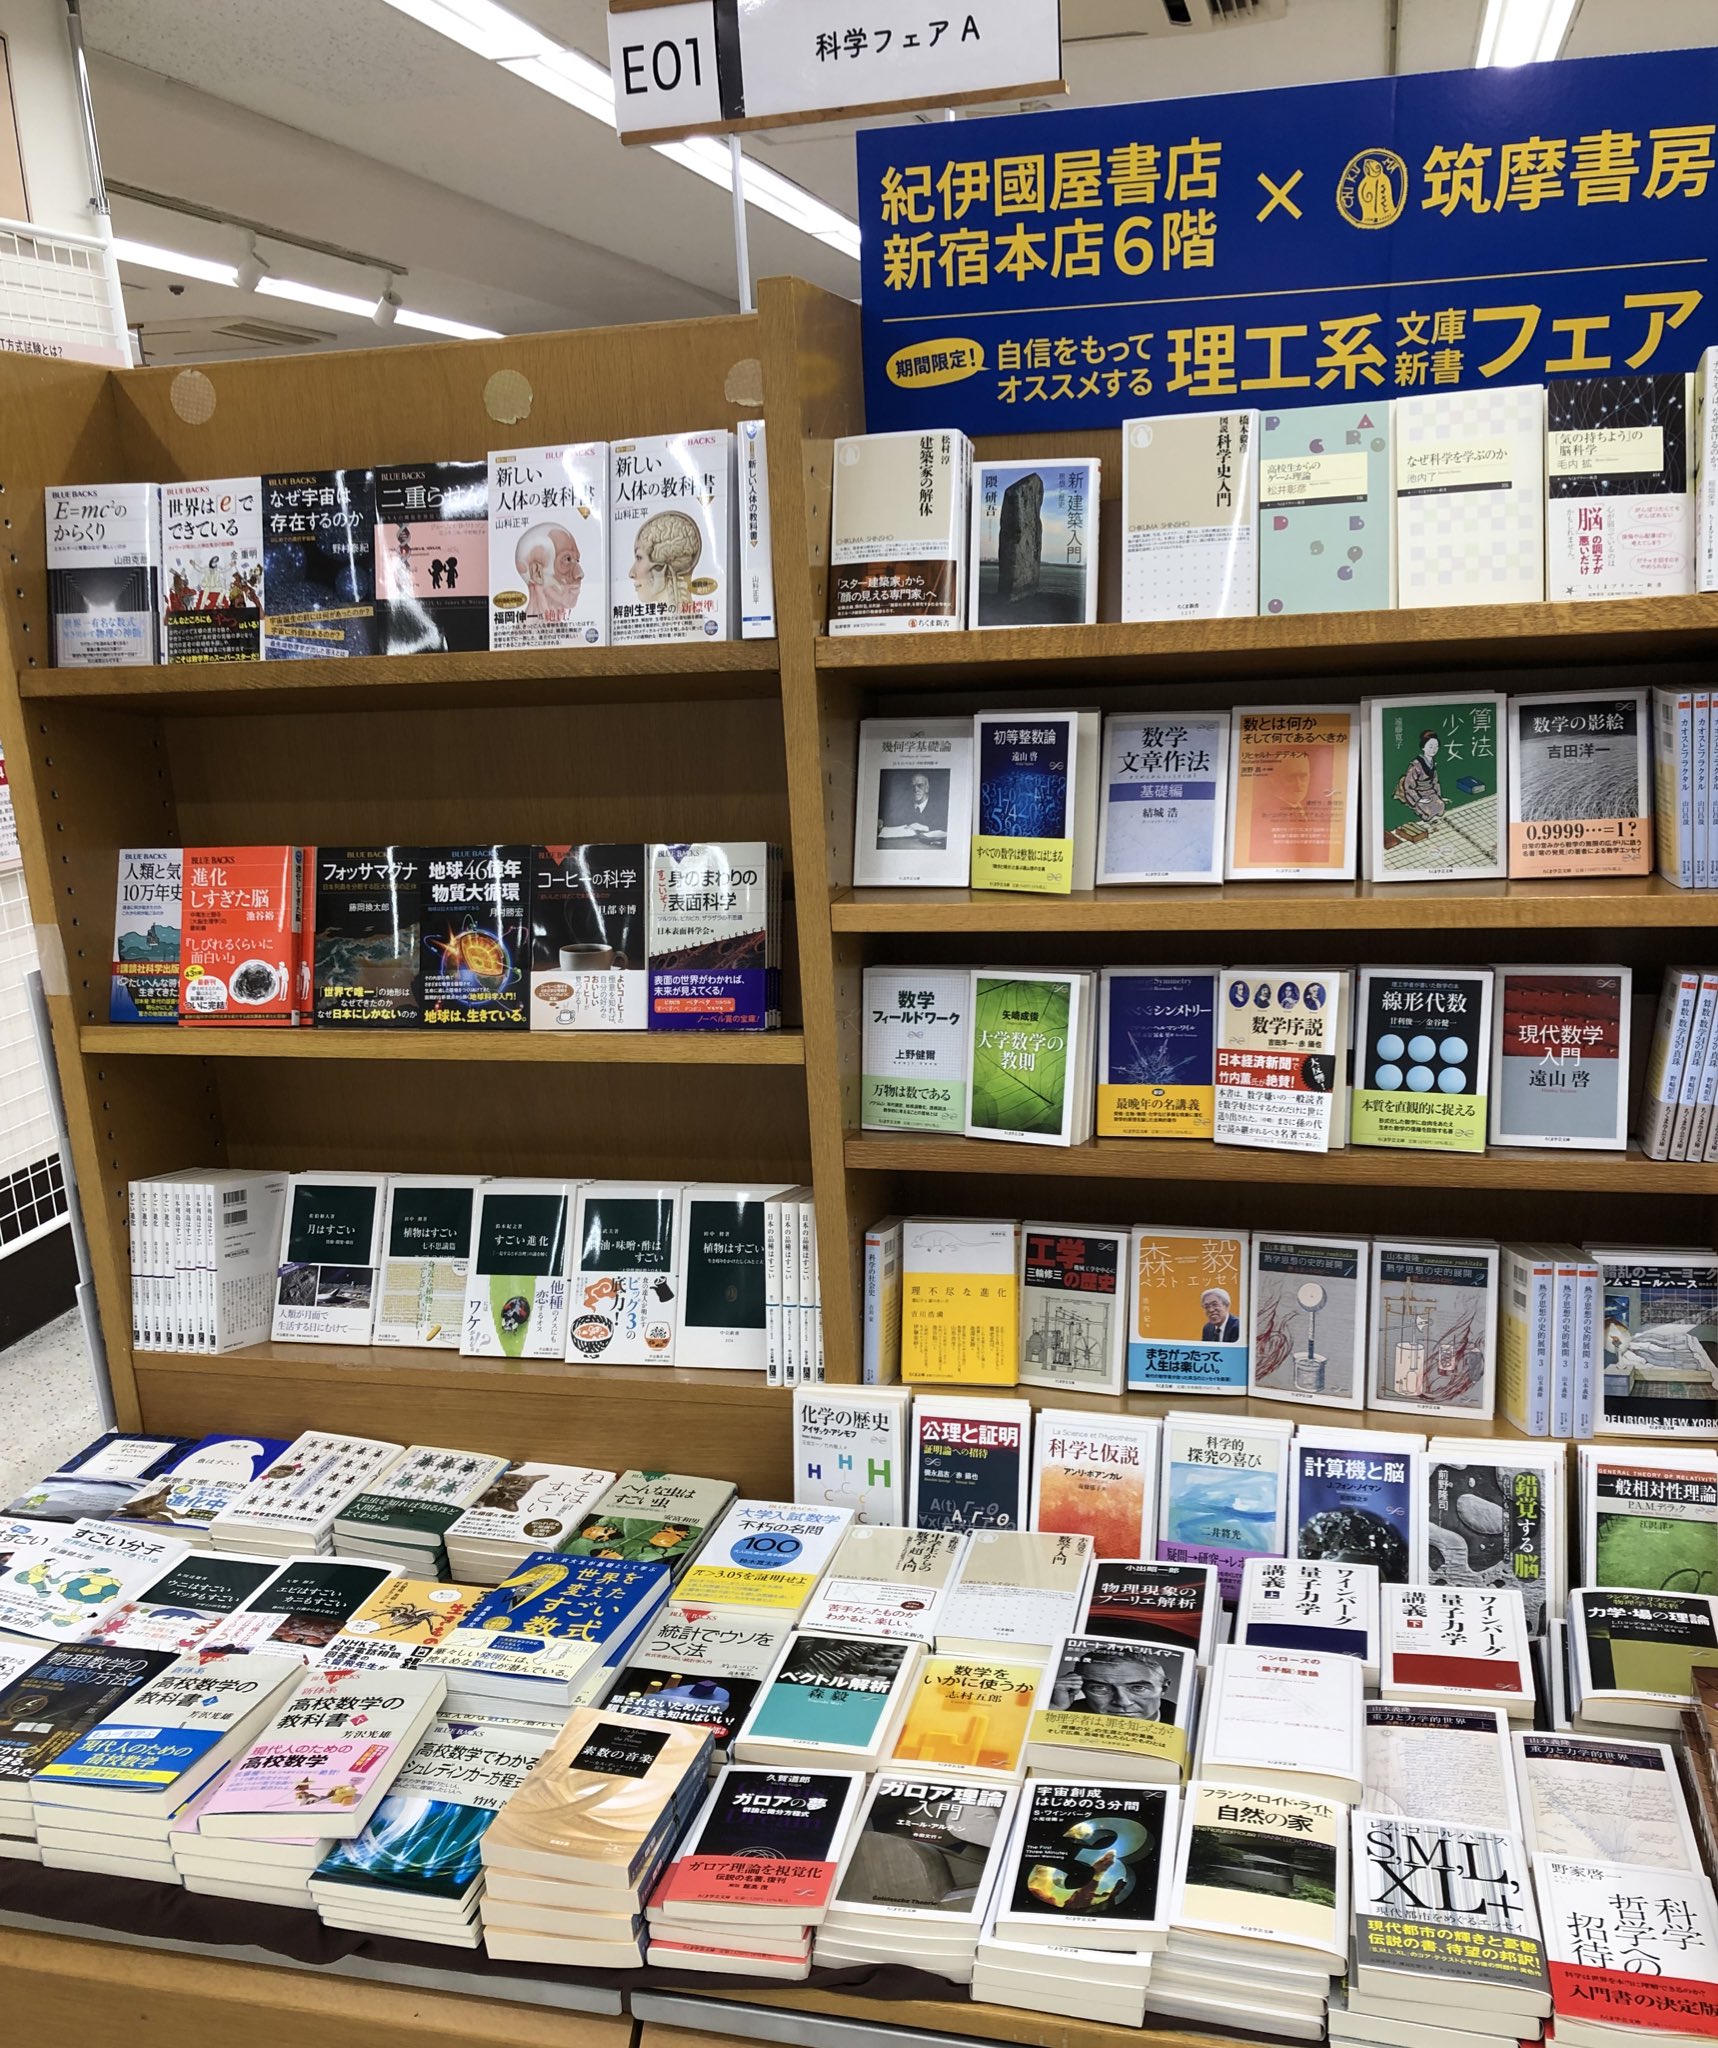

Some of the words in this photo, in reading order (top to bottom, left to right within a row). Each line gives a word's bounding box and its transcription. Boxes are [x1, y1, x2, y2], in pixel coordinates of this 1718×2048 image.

[815, 20, 950, 62] 科学フェア
[961, 15, 981, 42] A
[622, 37, 702, 95] E01
[880, 138, 1222, 226] 紀伊國屋書店
[1421, 124, 1716, 217] 筑摩書房
[883, 208, 1217, 291] 新宿本店6階
[1396, 308, 1467, 347] 文庫
[1472, 290, 1704, 378] フェア
[997, 333, 1154, 371] 自信をもって
[1166, 312, 1388, 397] 理工系
[895, 349, 977, 379] 期間限定!
[1395, 348, 1465, 386] 新書
[997, 368, 1154, 404] オススメする
[1407, 448, 1508, 467] なぜ科学を学ぶのか
[919, 435, 934, 518] 建築家の解体
[748, 461, 758, 542] 新しい人体の教科書
[1066, 471, 1084, 564] 新・建築入門
[54, 522, 106, 543] からくり
[168, 519, 239, 540] できている
[1579, 535, 1590, 575] 悪いだけ
[1592, 535, 1603, 575] の調子が
[1244, 717, 1317, 731] 数とは何か
[1470, 707, 1494, 758] 算法
[1532, 712, 1625, 735] 数学の影絵
[993, 729, 1057, 745] 初等整数論
[1141, 726, 1188, 749] 数学
[1243, 732, 1348, 745] そして何であるべきか
[1443, 713, 1465, 763] 少女
[1011, 752, 1028, 762] 遠山
[1546, 743, 1611, 760] 吉田洋一
[1680, 718, 1690, 791] カオスとフラクタル
[1697, 718, 1707, 791] カオスとフラクタル
[1118, 750, 1210, 774] 文章作法
[1140, 783, 1183, 798] 基礎編
[1142, 807, 1164, 819] 結城
[191, 867, 228, 887] 進化
[322, 862, 418, 881] フォッサマグナ
[538, 869, 637, 889] コーヒーの科学
[668, 869, 758, 887] 身のまわりの
[122, 884, 183, 902] 10万年史
[190, 888, 270, 909] しすぎた脳
[668, 892, 737, 912] 表面科学
[348, 903, 390, 913] 藤岡換太郎
[653, 974, 746, 986] 表面の世界がわかれば、
[319, 986, 411, 998] 「世界で唯一」の地形は
[591, 975, 599, 1013] おいしい
[653, 986, 724, 997] 未来が見えてくる!
[340, 999, 394, 1008] なぜできたのか
[1381, 990, 1468, 1014] 線形代数
[317, 1008, 418, 1020] なぜ日本にしかないのか
[424, 1008, 528, 1024] 地球は、生きている。
[872, 1010, 961, 1026] フィールドワーク
[1252, 1016, 1324, 1037] 数学序説
[1519, 1024, 1603, 1045] 現代数学
[977, 1030, 1064, 1053] 大学数学の
[894, 1049, 936, 1061] 上野健爾
[1000, 1053, 1036, 1071] 教則
[1538, 1046, 1582, 1067] 入門
[873, 1083, 951, 1102] 万物は数である
[1117, 1098, 1201, 1112] 最晩年の名講義
[1361, 1099, 1476, 1118] 本質を直観的に捉える
[307, 1223, 357, 1236] 月はすごい
[403, 1227, 459, 1239] 植物はすごい
[421, 1241, 456, 1251] 七不思議篇
[703, 1242, 765, 1254] 植物はすごい
[767, 1213, 776, 1280] 日本の品種はすごい
[784, 1213, 793, 1280] 日本の品種はすごい
[1026, 1238, 1086, 1269] 工学
[634, 1252, 664, 1263] すごい
[867, 1253, 876, 1297] 科学の社会史
[1026, 1267, 1063, 1280] 三輪修三
[1141, 1273, 1239, 1289] ベスト・エッセイ
[911, 1286, 1008, 1299] 理不尽な進化
[1603, 1278, 1698, 1289] レム・コールハース
[278, 1309, 329, 1321] 人類が月面で
[1145, 1347, 1224, 1364] まちがったって、
[1145, 1360, 1221, 1376] 人生は楽しい。
[800, 1404, 890, 1433] 化学の歴史
[802, 1424, 857, 1438] アイザック・アシモフ
[921, 1420, 1019, 1447] 公理と証明
[923, 1444, 989, 1460] 証明論への招待
[1048, 1438, 1140, 1466] 科学と仮説
[1206, 1436, 1244, 1452] 科学的
[1187, 1447, 1262, 1468] 探究の喜び
[1063, 1467, 1123, 1480] アンリ・ポアンカレ
[1304, 1456, 1405, 1484] 計算機と脳
[1598, 1467, 1631, 1475] GENERAL
[1633, 1470, 1662, 1478] THEORY
[1676, 1474, 1717, 1483] RELATIVITY
[1597, 1479, 1717, 1504] 一般相対性理論
[738, 1519, 824, 1536] 不朽の名問
[1513, 1472, 1539, 1580] 錯覚する脳
[72, 1527, 167, 1556] すごい分子
[743, 1537, 801, 1554] 100
[576, 1567, 645, 1586] 世界を
[1125, 1564, 1181, 1575] 小出昭一郎
[1261, 1564, 1287, 1589] 講義
[276, 1586, 342, 1597] エビはすごい
[559, 1582, 627, 1600] 変えた
[1101, 1582, 1197, 1598] 物理現象の
[1295, 1565, 1322, 1616] 量子力学
[1334, 1568, 1358, 1627] ワインバーグ
[281, 1596, 348, 1608] カニもすごい
[828, 1603, 919, 1620] 苦手だったものが
[1099, 1595, 1197, 1610] フーリエ解析
[825, 1612, 915, 1631] わかると、楽しい。
[1587, 1606, 1710, 1626] 力学・場の理論
[657, 1623, 776, 1647] 統計でウソを
[324, 1652, 370, 1663] 回答者の
[651, 1640, 709, 1658] つく法
[1067, 1639, 1181, 1658] ロバート・オッペンハイマー
[47, 1652, 148, 1673] 物理数学の
[1257, 1653, 1321, 1665] ペンローズの
[953, 1664, 1010, 1680] 数学を
[154, 1675, 259, 1694] 高校数学の
[779, 1670, 893, 1695] ベクトル解析
[923, 1675, 1035, 1694] いかに使うか
[134, 1690, 204, 1707] 教科書
[808, 1688, 825, 1700] 森
[188, 1710, 236, 1721] 芳沢光雄
[1045, 1711, 1177, 1738] 物理学者は、罪を知ったか?
[1371, 1713, 1467, 1725] 重力と力学的世界
[341, 1729, 392, 1740] 芳沢光雄
[78, 1738, 193, 1758] 現代人のための
[252, 1743, 353, 1755] 現代人のための
[414, 1742, 540, 1771] 高校数学でわかる
[580, 1744, 655, 1764] 素数の音楽
[765, 1773, 812, 1785] 久賀道郎
[732, 1792, 829, 1812] ガロアの夢
[878, 1780, 1006, 1808] ガロア理論
[1035, 1786, 1103, 1799] 宇宙創成
[1201, 1787, 1334, 1815] フランク・ロイド・ライト
[1033, 1809, 1092, 1818] S・ワインバーグ
[1034, 1797, 1141, 1812] はじめの3分間
[1217, 1804, 1315, 1834] 自然の家
[688, 1860, 824, 1880] ガロア理論を視覚化
[1375, 1906, 1525, 1933] 現代都市をめぐるエッセイ
[1654, 1897, 1707, 1951] 科学
[1367, 1919, 1539, 1954] 現代都市の輝きと憂鬱
[1566, 1911, 1615, 1969] 招待
[1608, 1893, 1662, 1977] 哲学への
[1368, 1934, 1542, 1970] 伝説の書、待望の邦訳!
